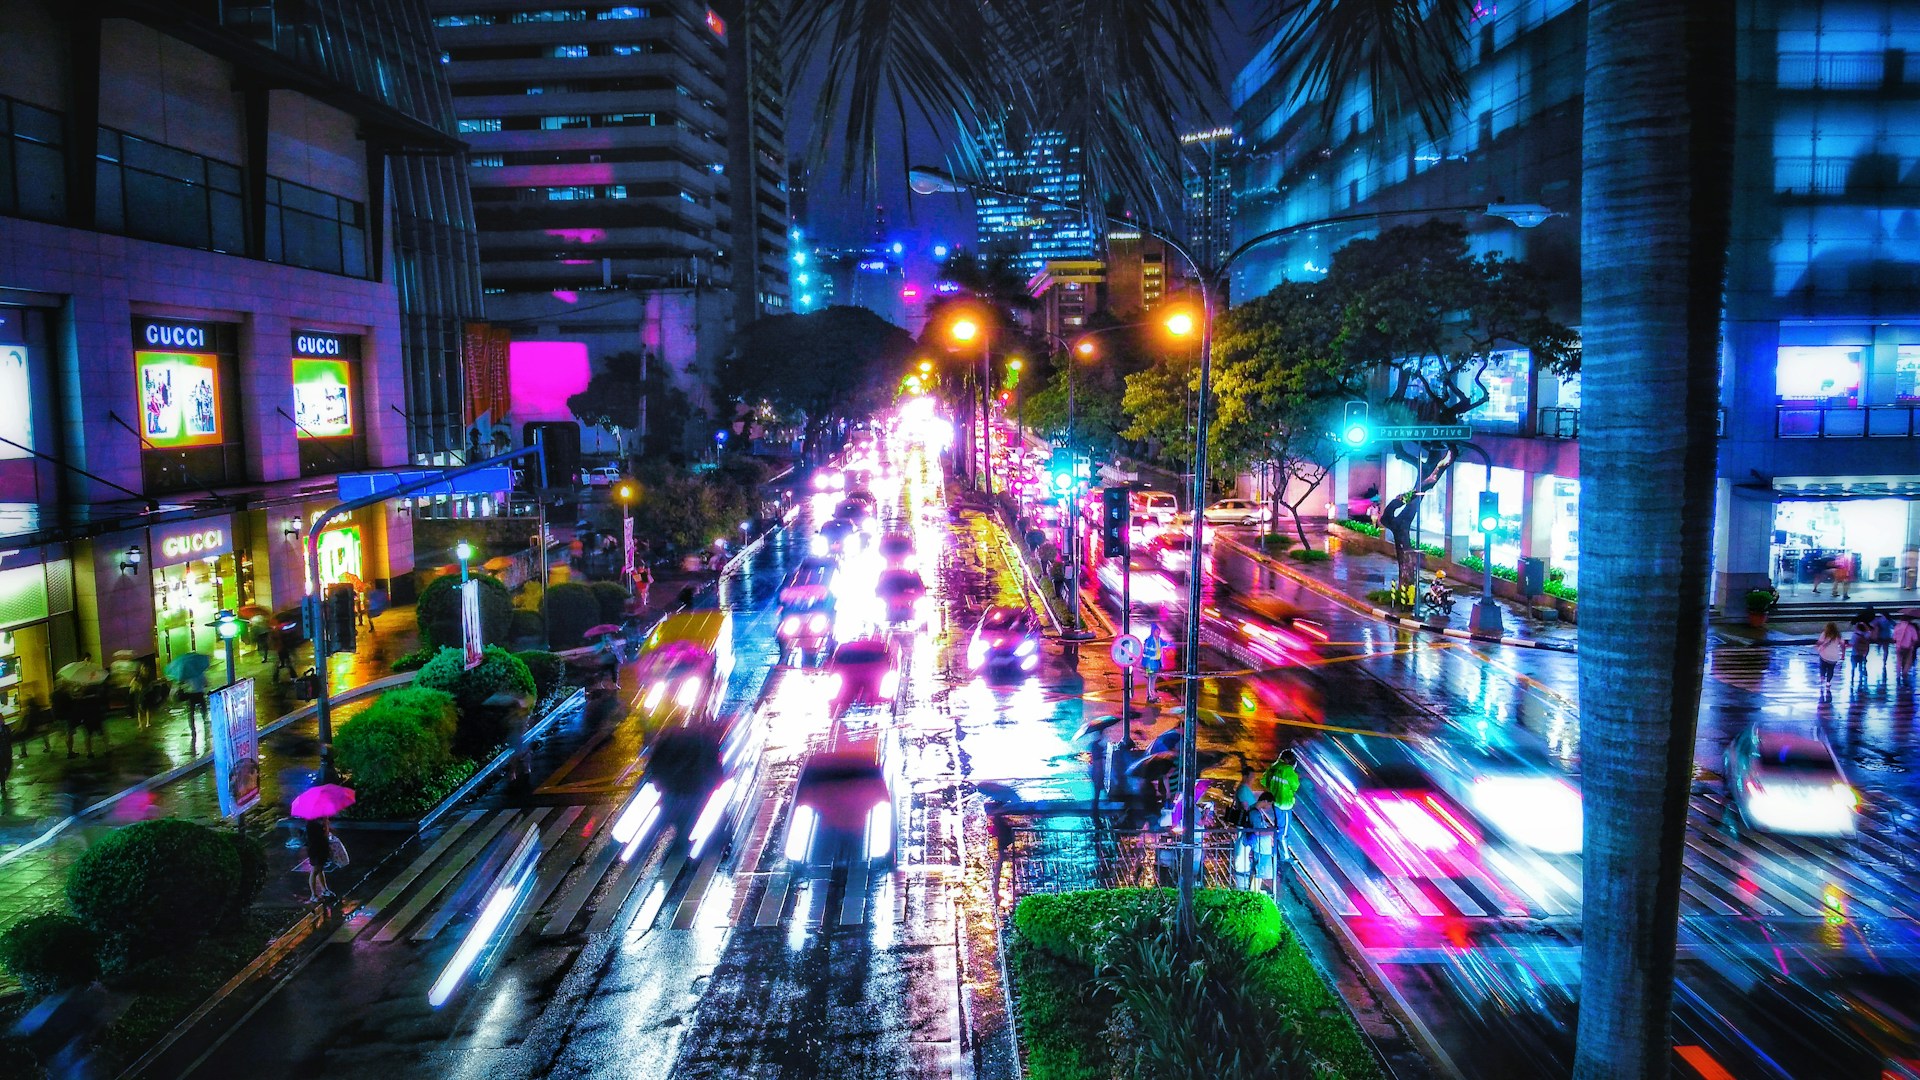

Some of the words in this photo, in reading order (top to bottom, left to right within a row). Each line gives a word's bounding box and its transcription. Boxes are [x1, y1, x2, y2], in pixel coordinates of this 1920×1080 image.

[146, 325, 204, 346] GUCCI
[297, 336, 339, 355] GUCCI
[1380, 428, 1426, 438] Parkway
[1433, 428, 1462, 436] Drive
[163, 530, 222, 557] GUCCI
